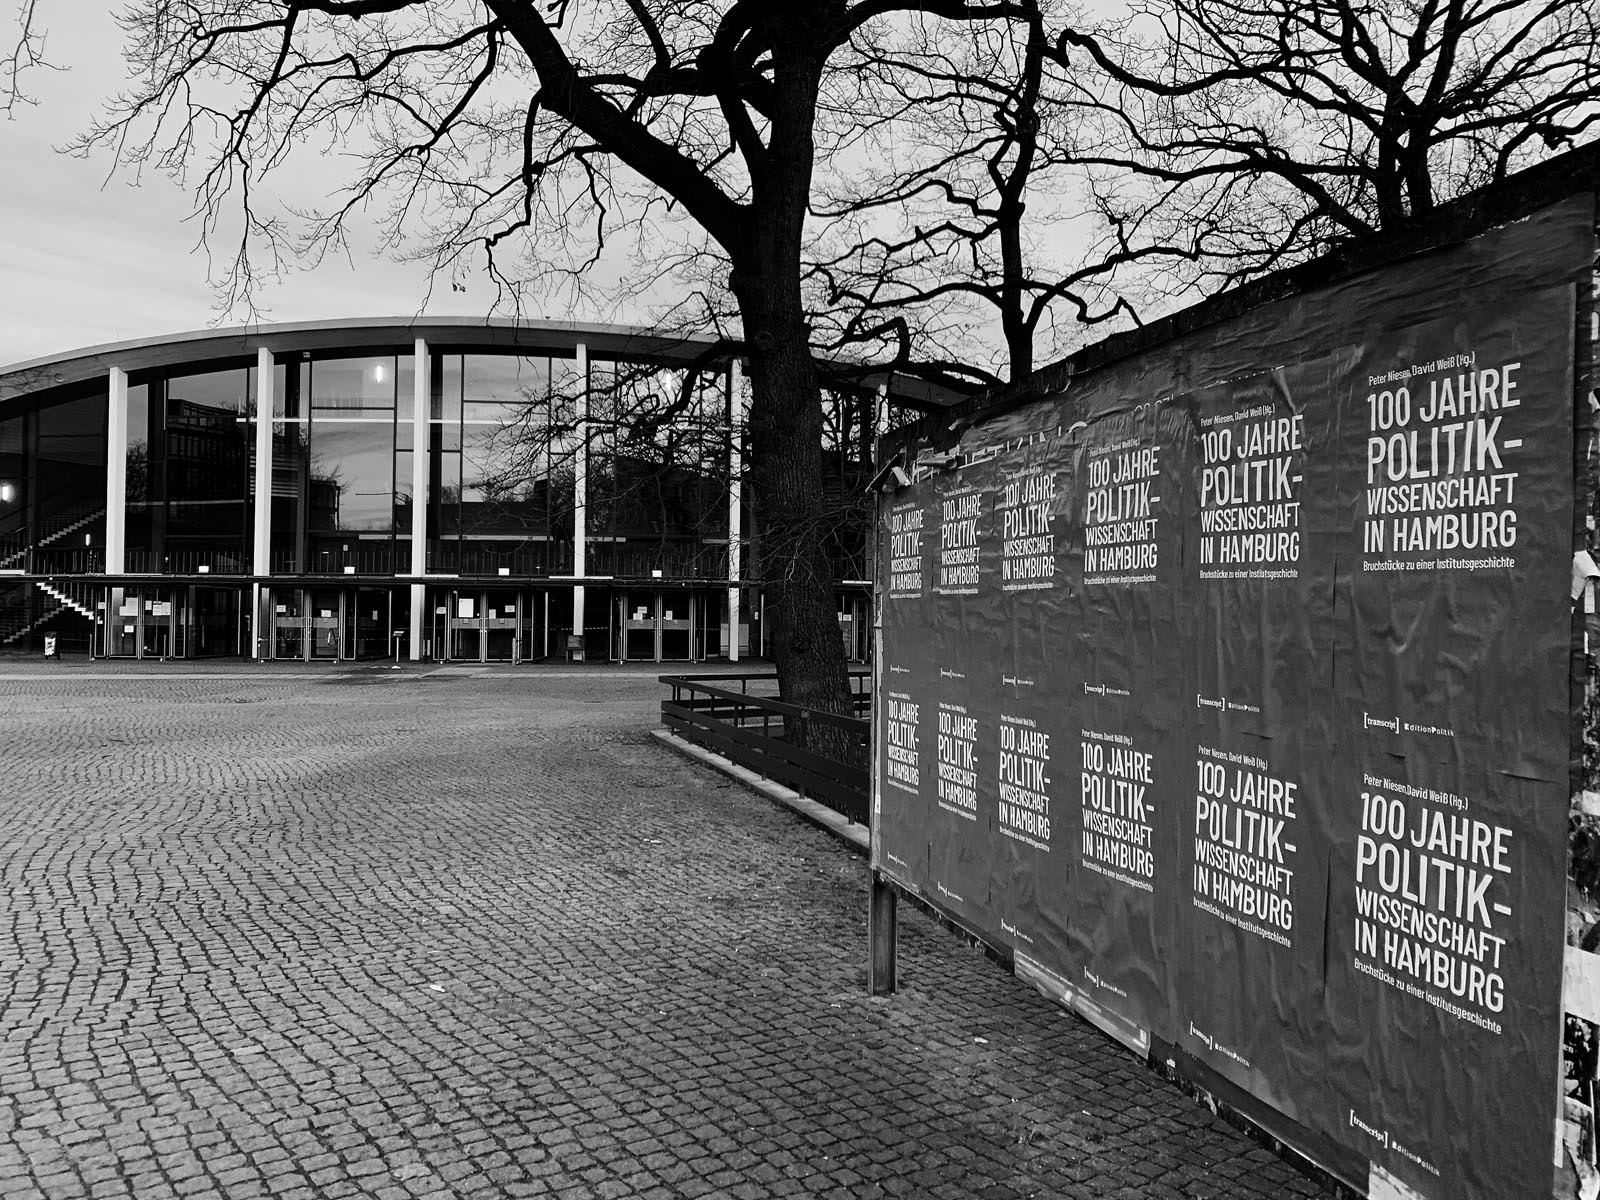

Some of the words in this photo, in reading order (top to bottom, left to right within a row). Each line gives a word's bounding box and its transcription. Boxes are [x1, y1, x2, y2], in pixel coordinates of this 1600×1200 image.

[1369, 375, 1386, 386] Peter
[1412, 363, 1435, 376] David
[1437, 357, 1455, 370] Weiß
[1457, 351, 1475, 368] (Hg.)
[1367, 387, 1410, 431] 100
[1420, 363, 1520, 422] JAHRE
[1201, 429, 1231, 464] 100
[1237, 415, 1303, 458] JAHRE
[1368, 416, 1522, 484] POLITIK-
[1089, 459, 1110, 488] 100
[1113, 446, 1160, 483] JAHRE
[1201, 456, 1302, 507] POLITIK-
[943, 500, 955, 521] 100
[957, 494, 982, 519] JAHRE
[1005, 482, 1020, 507] 100
[1022, 473, 1056, 504] JAHRE
[1086, 481, 1160, 524] POLITIK-
[1367, 473, 1518, 515] WISSENSCHAFT
[892, 514, 902, 533] 100
[942, 519, 981, 549] POLITIK-
[1004, 502, 1055, 539] POLITIK-
[1086, 519, 1158, 546] WISSENSCHAFT
[1201, 502, 1300, 532] WISSENSCHAFT
[1364, 520, 1384, 552] IN
[1393, 510, 1516, 551] HAMBURG
[891, 532, 923, 558] POLITIK-
[942, 547, 980, 565] WISSENSCHAFT
[1004, 535, 1054, 557] WISSENSCHAFT
[1085, 549, 1096, 572] IN
[1100, 543, 1157, 571] HAMBURG
[1201, 537, 1213, 563] IN
[1220, 532, 1299, 563] HAMBURG
[941, 568, 947, 585] IN
[949, 565, 979, 584] HAMBURG
[1003, 560, 1010, 580] IN
[1013, 556, 1054, 579] HAMBURG
[1364, 560, 1404, 571] Bruchstücke
[1406, 562, 1415, 570] zu
[1417, 559, 1435, 570] einer
[1437, 557, 1514, 571] Institutsgeschichte
[888, 700, 897, 719] 100
[899, 702, 919, 724] JAHRE
[939, 712, 951, 734] 100
[953, 715, 977, 741] JAHRE
[888, 720, 919, 749] POLITIK-
[939, 734, 978, 770] POLITIK-
[1000, 725, 1015, 751] 100
[1017, 729, 1049, 760] JAHRE
[1000, 751, 1050, 793] POLITIK-
[1081, 742, 1103, 772] 100
[1107, 747, 1153, 784] JAHRE
[1199, 745, 1211, 756] Peter
[1229, 752, 1242, 763] David
[938, 779, 944, 798] IN
[945, 781, 976, 811] HAMBURG
[999, 782, 1049, 815] WISSENSCHAFT
[1082, 772, 1154, 822] POLITIK-
[1197, 760, 1225, 798] 100
[1230, 770, 1297, 819] JAHRE
[1364, 774, 1382, 787] Peter
[1407, 785, 1428, 799] David
[1429, 790, 1448, 804] Weiß
[1450, 793, 1468, 810] (Hg.)
[999, 801, 1008, 824] IN
[1010, 806, 1050, 840] HAMBURG
[1082, 807, 1152, 848] WISSENSCHAFT
[1196, 795, 1296, 864] POLITIK-
[1361, 793, 1405, 839] 100
[1411, 808, 1512, 873] JAHRE
[1083, 831, 1093, 857] IN
[1096, 835, 1153, 877] HAMBURG
[1195, 837, 1293, 895] WISSENSCHAFT
[1194, 864, 1208, 896] IN
[1213, 871, 1293, 930] HAMBURG
[1357, 835, 1511, 928] POLITIK-
[1356, 886, 1505, 968] WISSENSCHAFT
[1355, 918, 1376, 958] IN
[1384, 930, 1503, 1013] HAMBURG
[1354, 958, 1394, 986] Bruchstücke
[1396, 979, 1404, 990] zu
[1407, 983, 1424, 999] einer
[1426, 991, 1501, 1034] Institutsgeschichte
